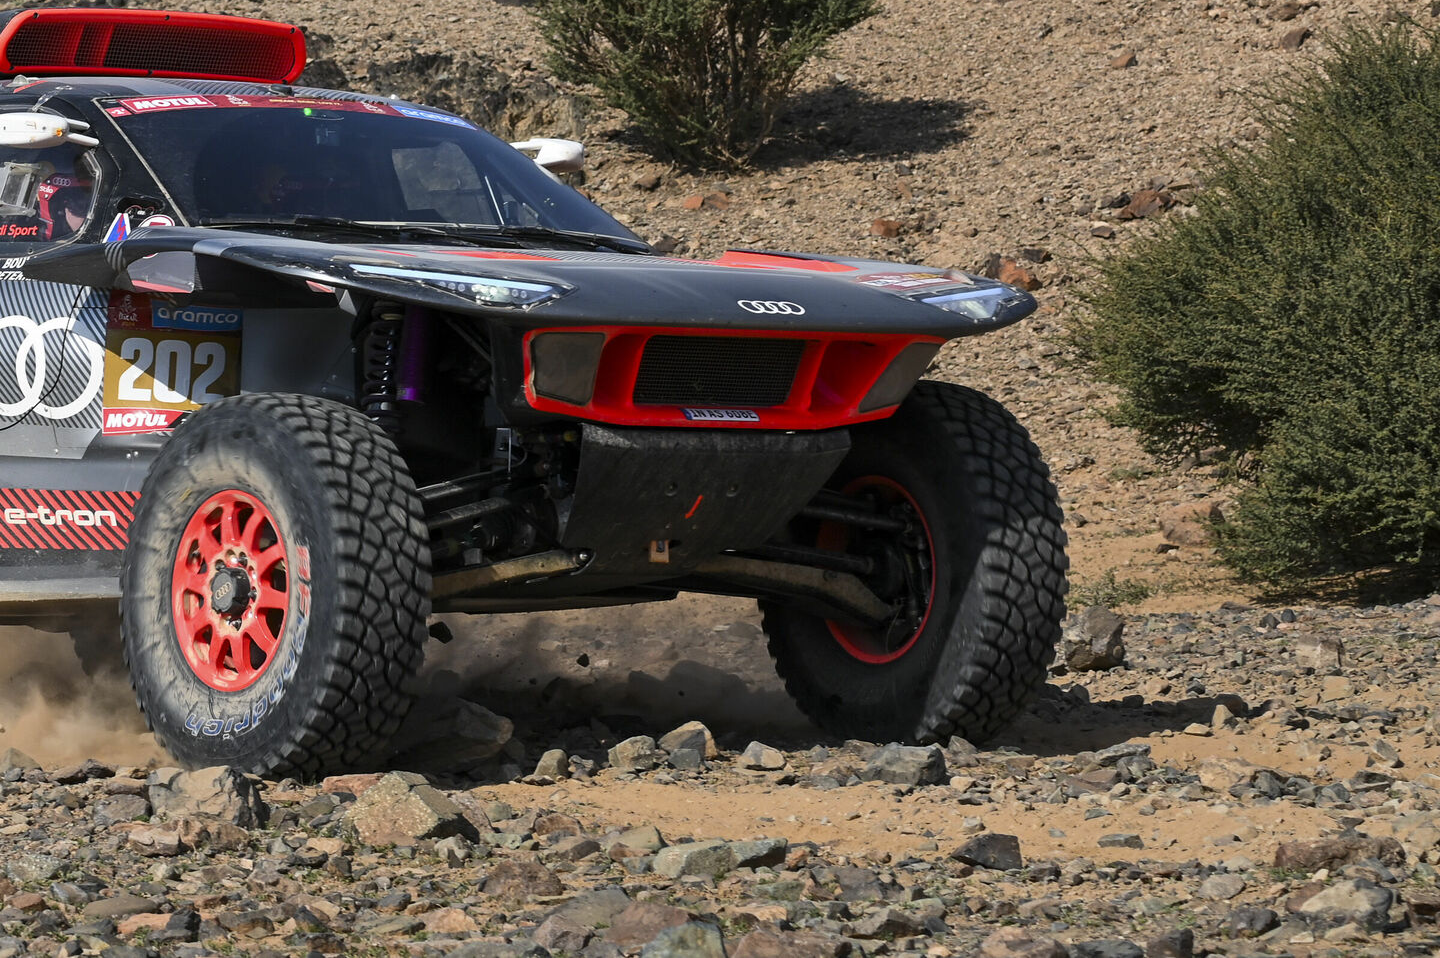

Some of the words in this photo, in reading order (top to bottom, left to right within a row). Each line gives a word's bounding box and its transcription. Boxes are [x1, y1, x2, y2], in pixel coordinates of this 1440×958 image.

[133, 96, 208, 110] MOTUL
[8, 223, 39, 239] Sport
[157, 306, 239, 325] aramco
[117, 337, 227, 405] 202
[105, 413, 168, 428] MOTUL
[4, 505, 118, 527] e-tron
